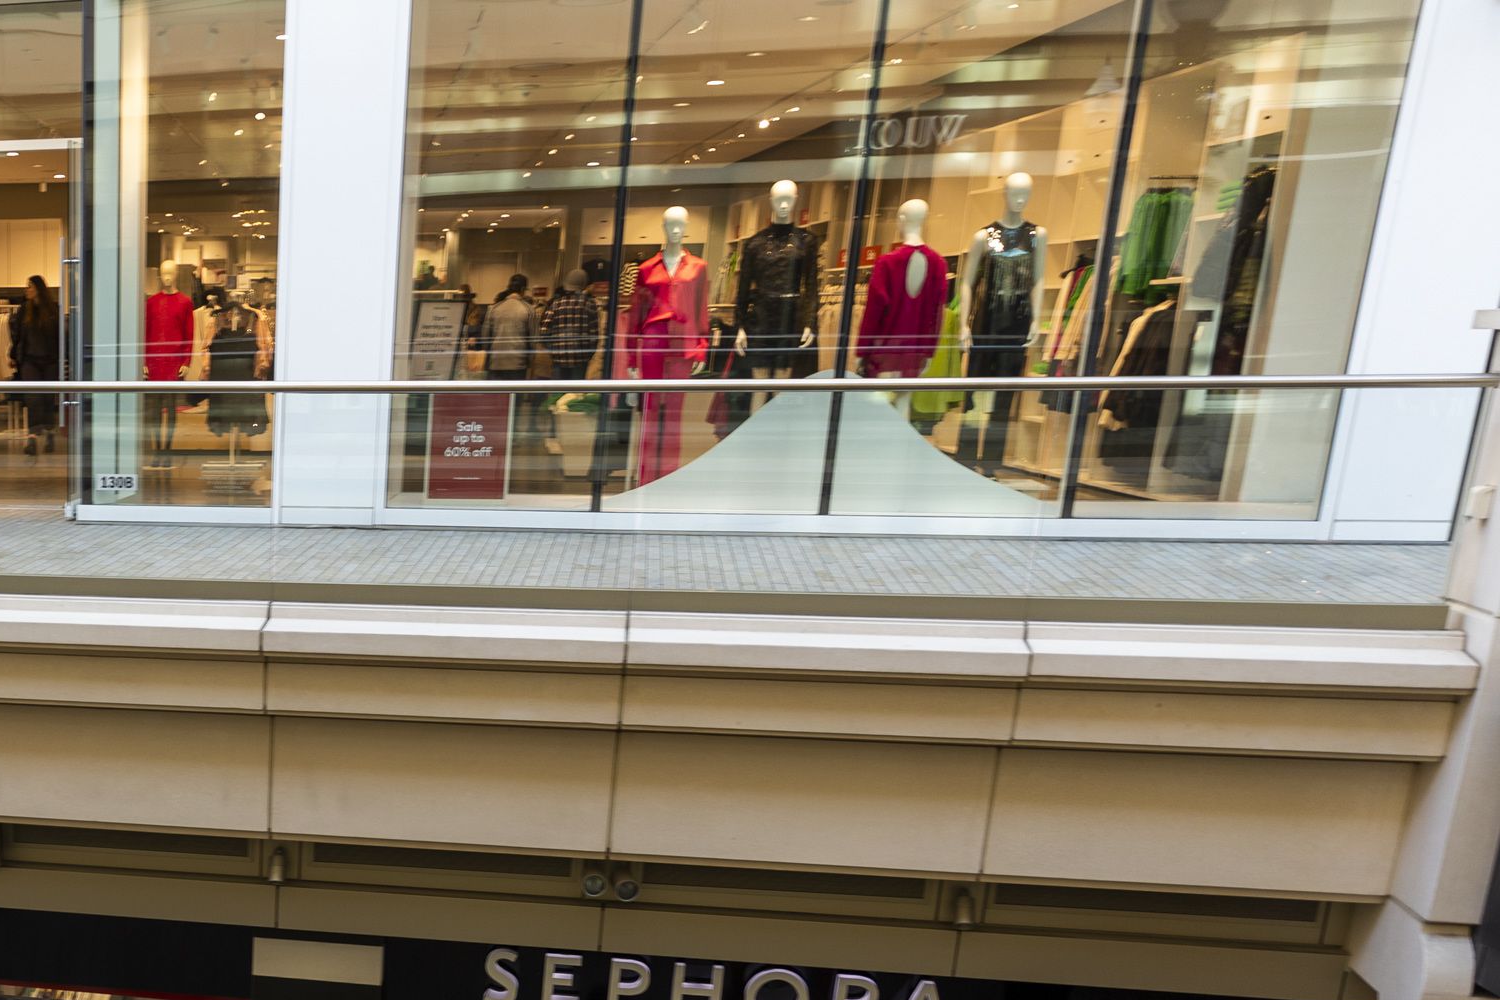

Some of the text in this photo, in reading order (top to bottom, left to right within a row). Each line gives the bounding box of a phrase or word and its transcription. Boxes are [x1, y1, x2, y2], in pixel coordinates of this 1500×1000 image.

[456, 421, 484, 432] Sale
[453, 434, 485, 446] up to
[444, 446, 492, 457] 60% off
